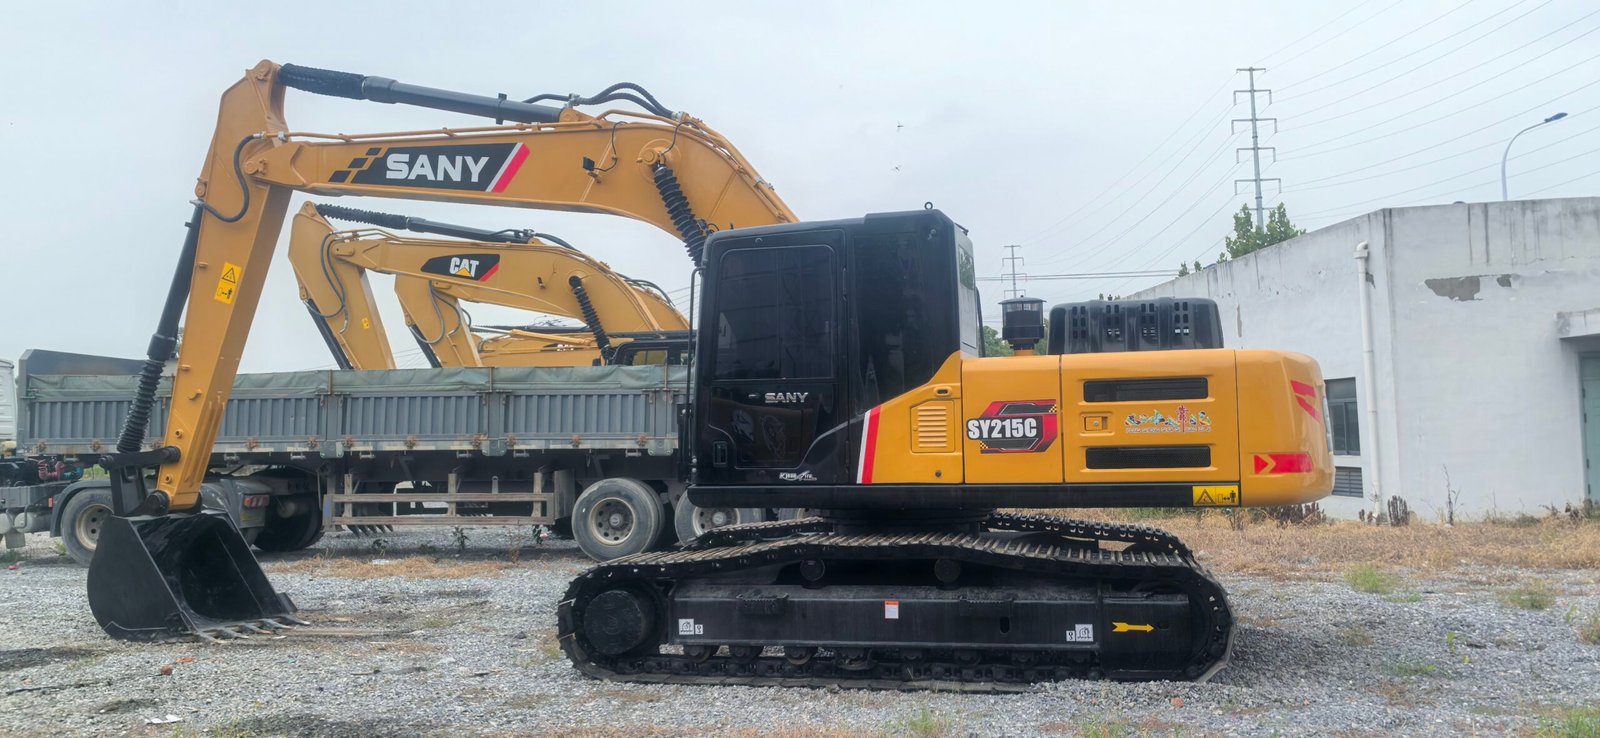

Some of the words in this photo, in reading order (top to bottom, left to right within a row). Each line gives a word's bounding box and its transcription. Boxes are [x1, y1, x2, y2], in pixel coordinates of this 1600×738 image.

[385, 153, 490, 182] SANY
[449, 257, 480, 278] CAT
[764, 392, 809, 404] SANY
[967, 418, 1037, 439] SY215C
